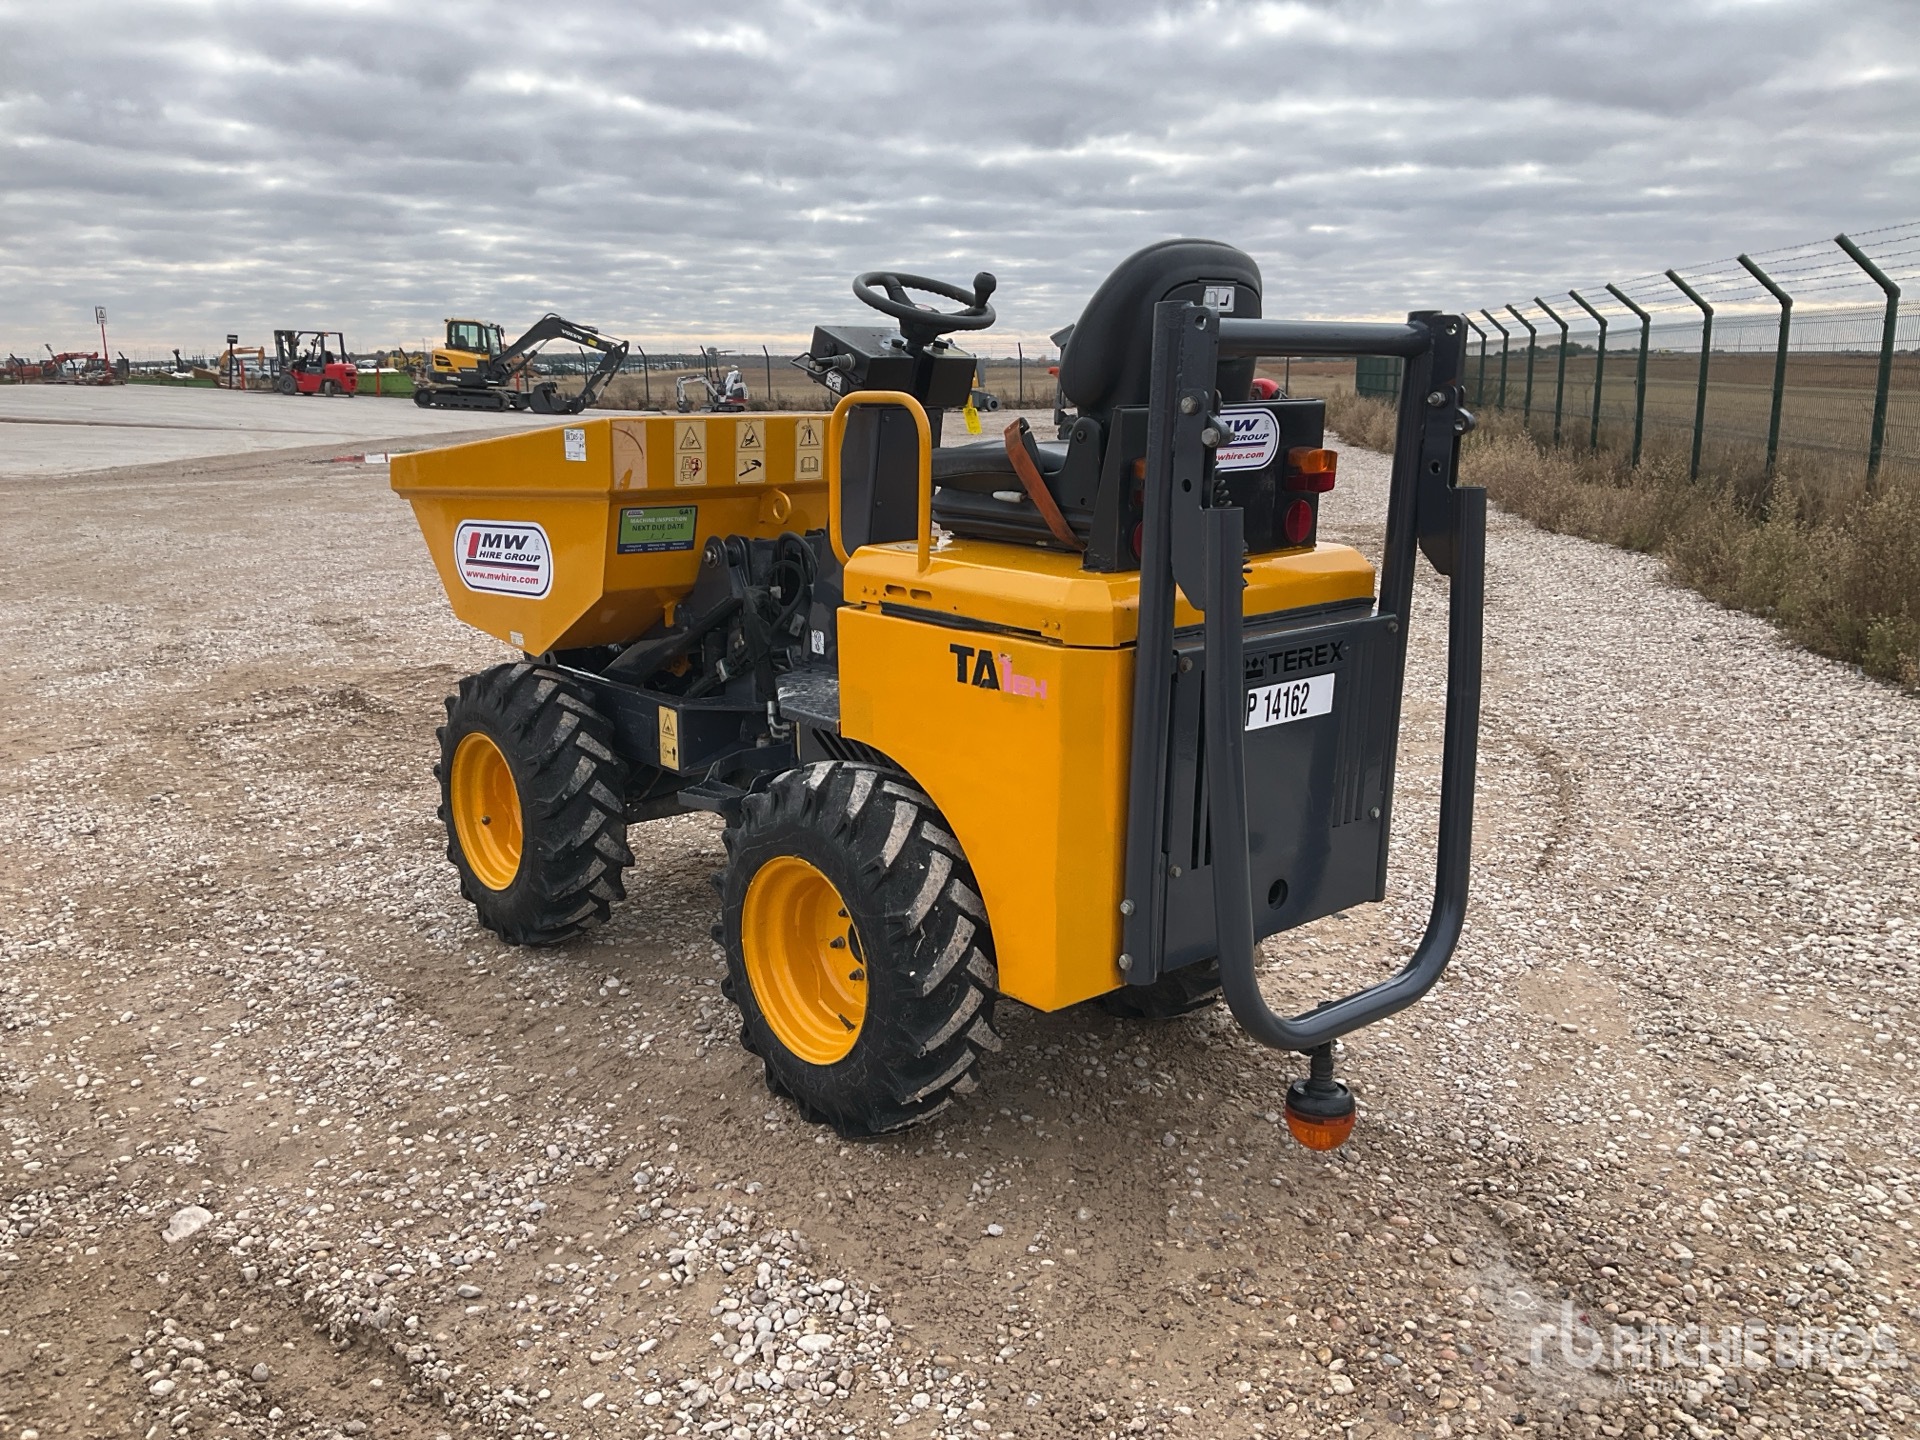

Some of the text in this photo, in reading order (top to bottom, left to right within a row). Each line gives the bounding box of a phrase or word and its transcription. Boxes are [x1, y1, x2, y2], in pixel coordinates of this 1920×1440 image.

[561, 328, 583, 341] VOLVO
[1232, 433, 1270, 442] GROUP
[1216, 451, 1265, 461] whire.com
[481, 533, 529, 550] MW
[478, 550, 541, 563] HIRE GROUP
[466, 570, 539, 585] www.mwhire.com
[1268, 640, 1344, 675] TEREX
[1264, 682, 1310, 723] 14162
